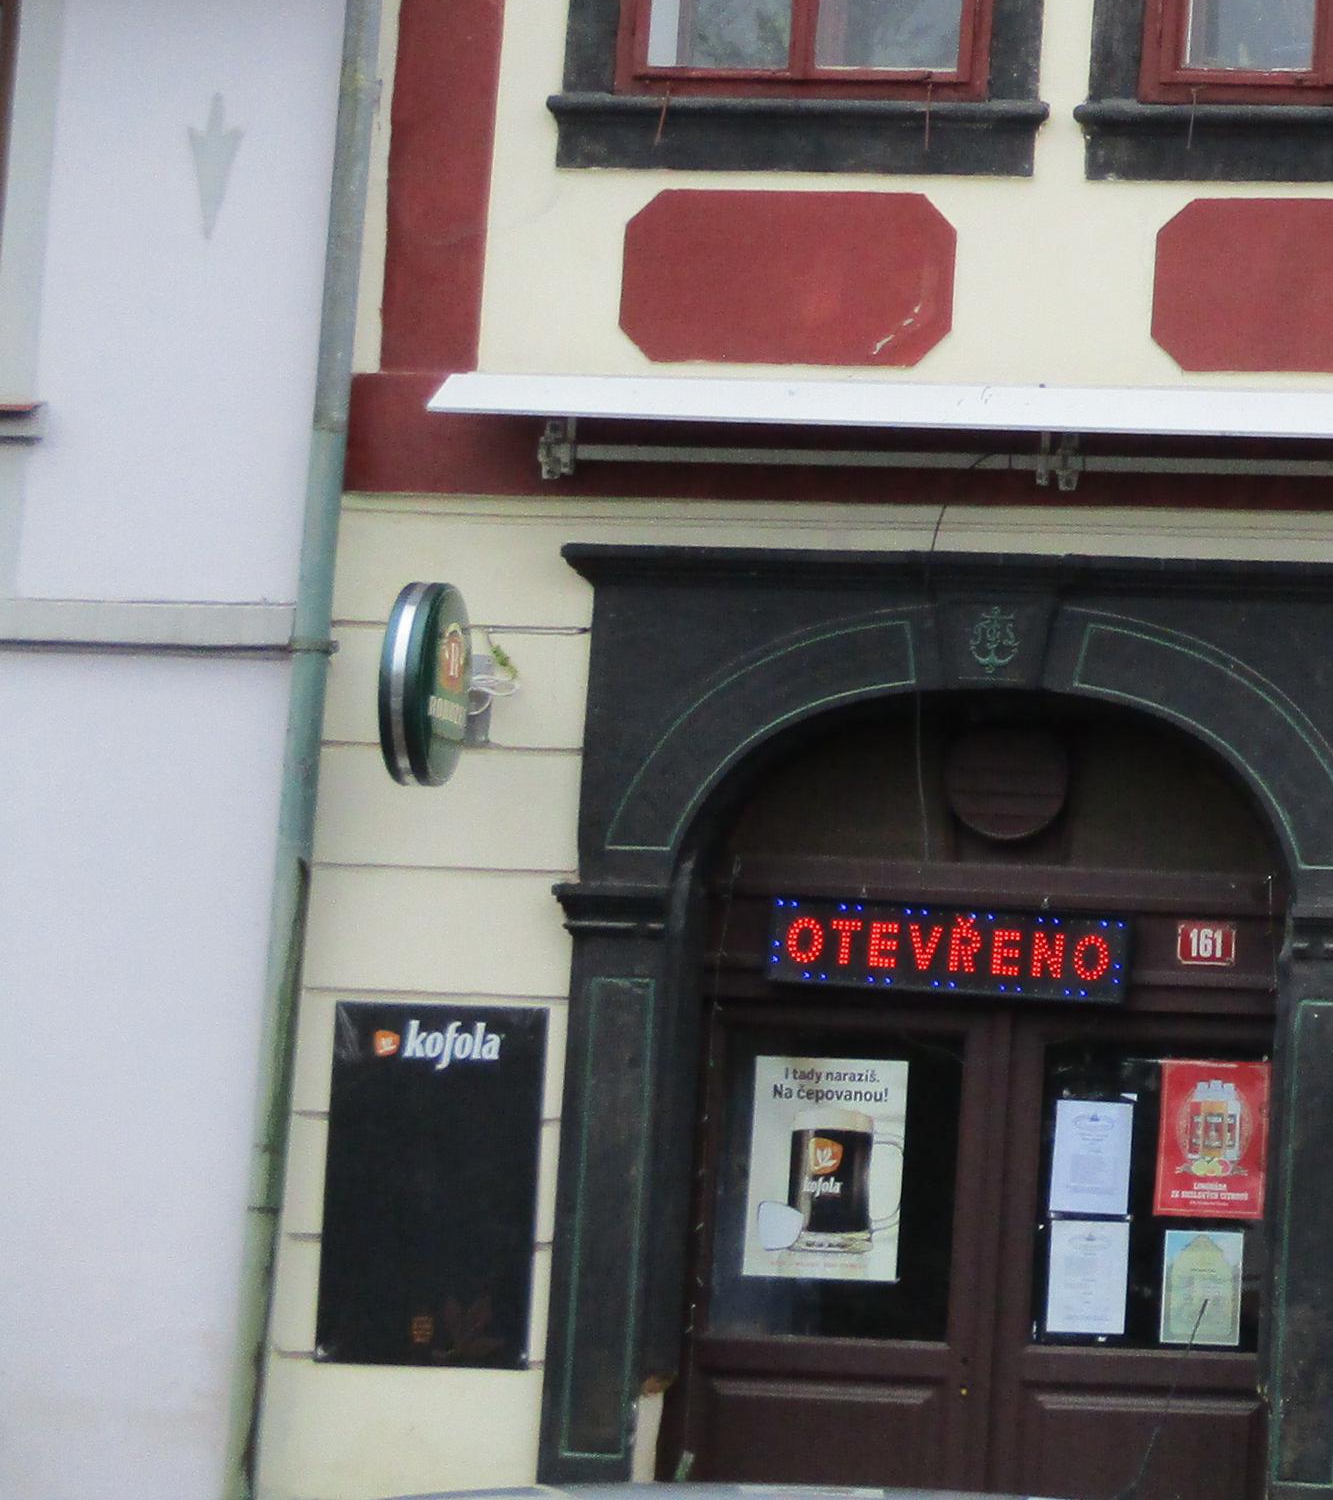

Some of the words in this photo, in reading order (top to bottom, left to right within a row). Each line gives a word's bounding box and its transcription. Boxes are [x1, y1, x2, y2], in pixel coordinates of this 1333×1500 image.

[786, 914, 1110, 981] OTEVŘENO
[1189, 930, 1223, 959] 161
[402, 1019, 501, 1071] kofola
[792, 1068, 823, 1084] tady
[825, 1069, 880, 1082] narazíš.
[773, 1083, 793, 1099] Na
[797, 1084, 889, 1104] čepovanou!
[803, 1176, 843, 1198] kofola
